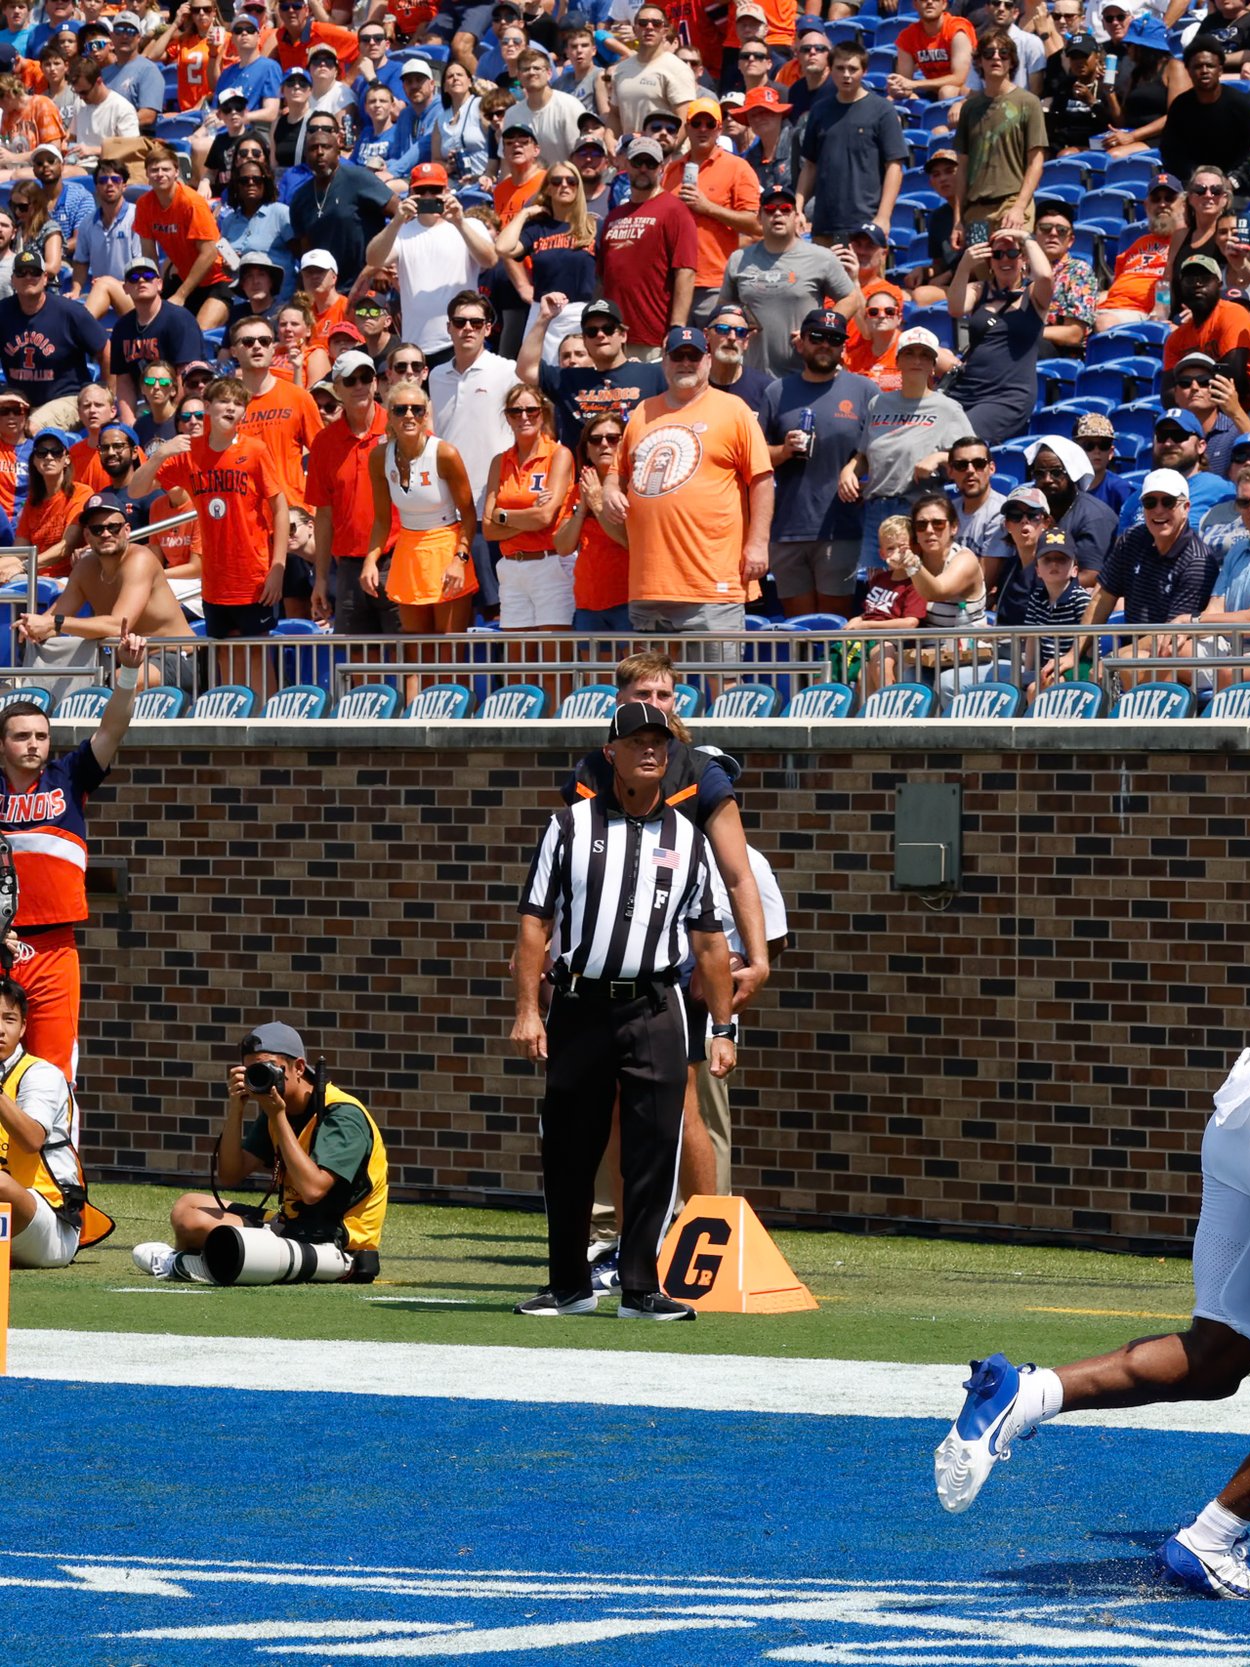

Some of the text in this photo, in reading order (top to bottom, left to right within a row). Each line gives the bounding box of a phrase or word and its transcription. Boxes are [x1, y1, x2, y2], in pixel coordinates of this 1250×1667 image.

[187, 51, 203, 84] 2
[604, 228, 646, 241] FAMILY
[574, 386, 640, 402] ILLINOIS
[240, 408, 293, 425] LINOIS
[870, 414, 937, 428] ILLINOIS
[189, 468, 248, 496] ILLINOIS
[420, 471, 432, 487] I
[529, 473, 547, 493] I
[1046, 533, 1066, 545] M
[58, 693, 109, 719] DUKE
[194, 693, 248, 719] DUKE
[265, 692, 320, 719] DUKE
[337, 692, 390, 719] DUKE
[408, 692, 464, 719] DUKE
[482, 692, 538, 719] DUKE
[560, 692, 616, 719] DUKE
[712, 692, 768, 718] DUKE
[789, 691, 846, 718] DUKE
[864, 689, 925, 718] DUKE
[950, 690, 1011, 718] DUKE
[1032, 689, 1095, 718] DUKE
[1118, 689, 1182, 718] DUKE
[592, 839, 605, 854] S
[653, 889, 669, 909] F
[663, 1216, 732, 1299] G
